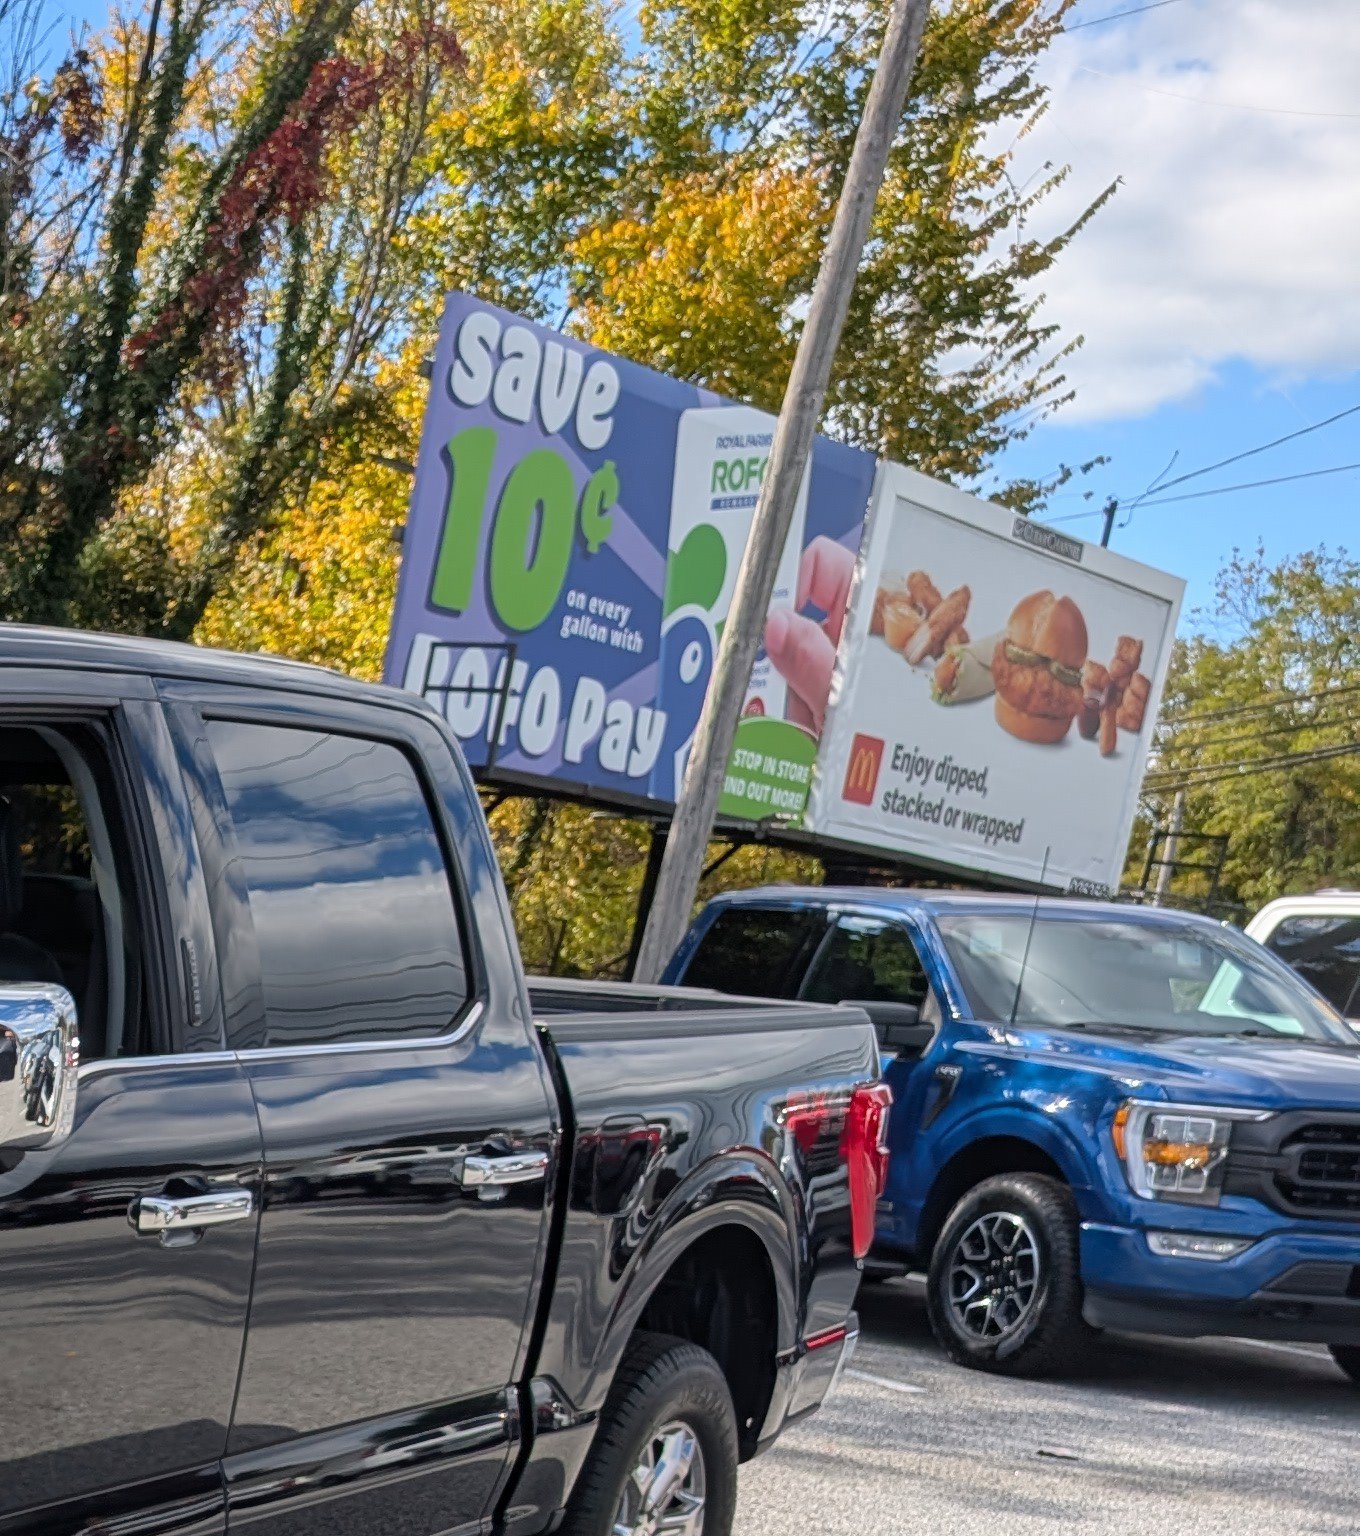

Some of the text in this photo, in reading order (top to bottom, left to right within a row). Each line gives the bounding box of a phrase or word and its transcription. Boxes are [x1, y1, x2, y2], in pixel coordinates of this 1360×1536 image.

[451, 312, 620, 450] save
[566, 589, 632, 628] on every
[560, 614, 644, 654] gallon with
[564, 676, 667, 778] Pay
[723, 775, 746, 797] IND
[746, 780, 771, 803] OUT
[733, 748, 810, 784] STOP IN STORE
[891, 743, 989, 799] Enjoy dipped,
[881, 787, 1026, 847] stacked or wrapped
